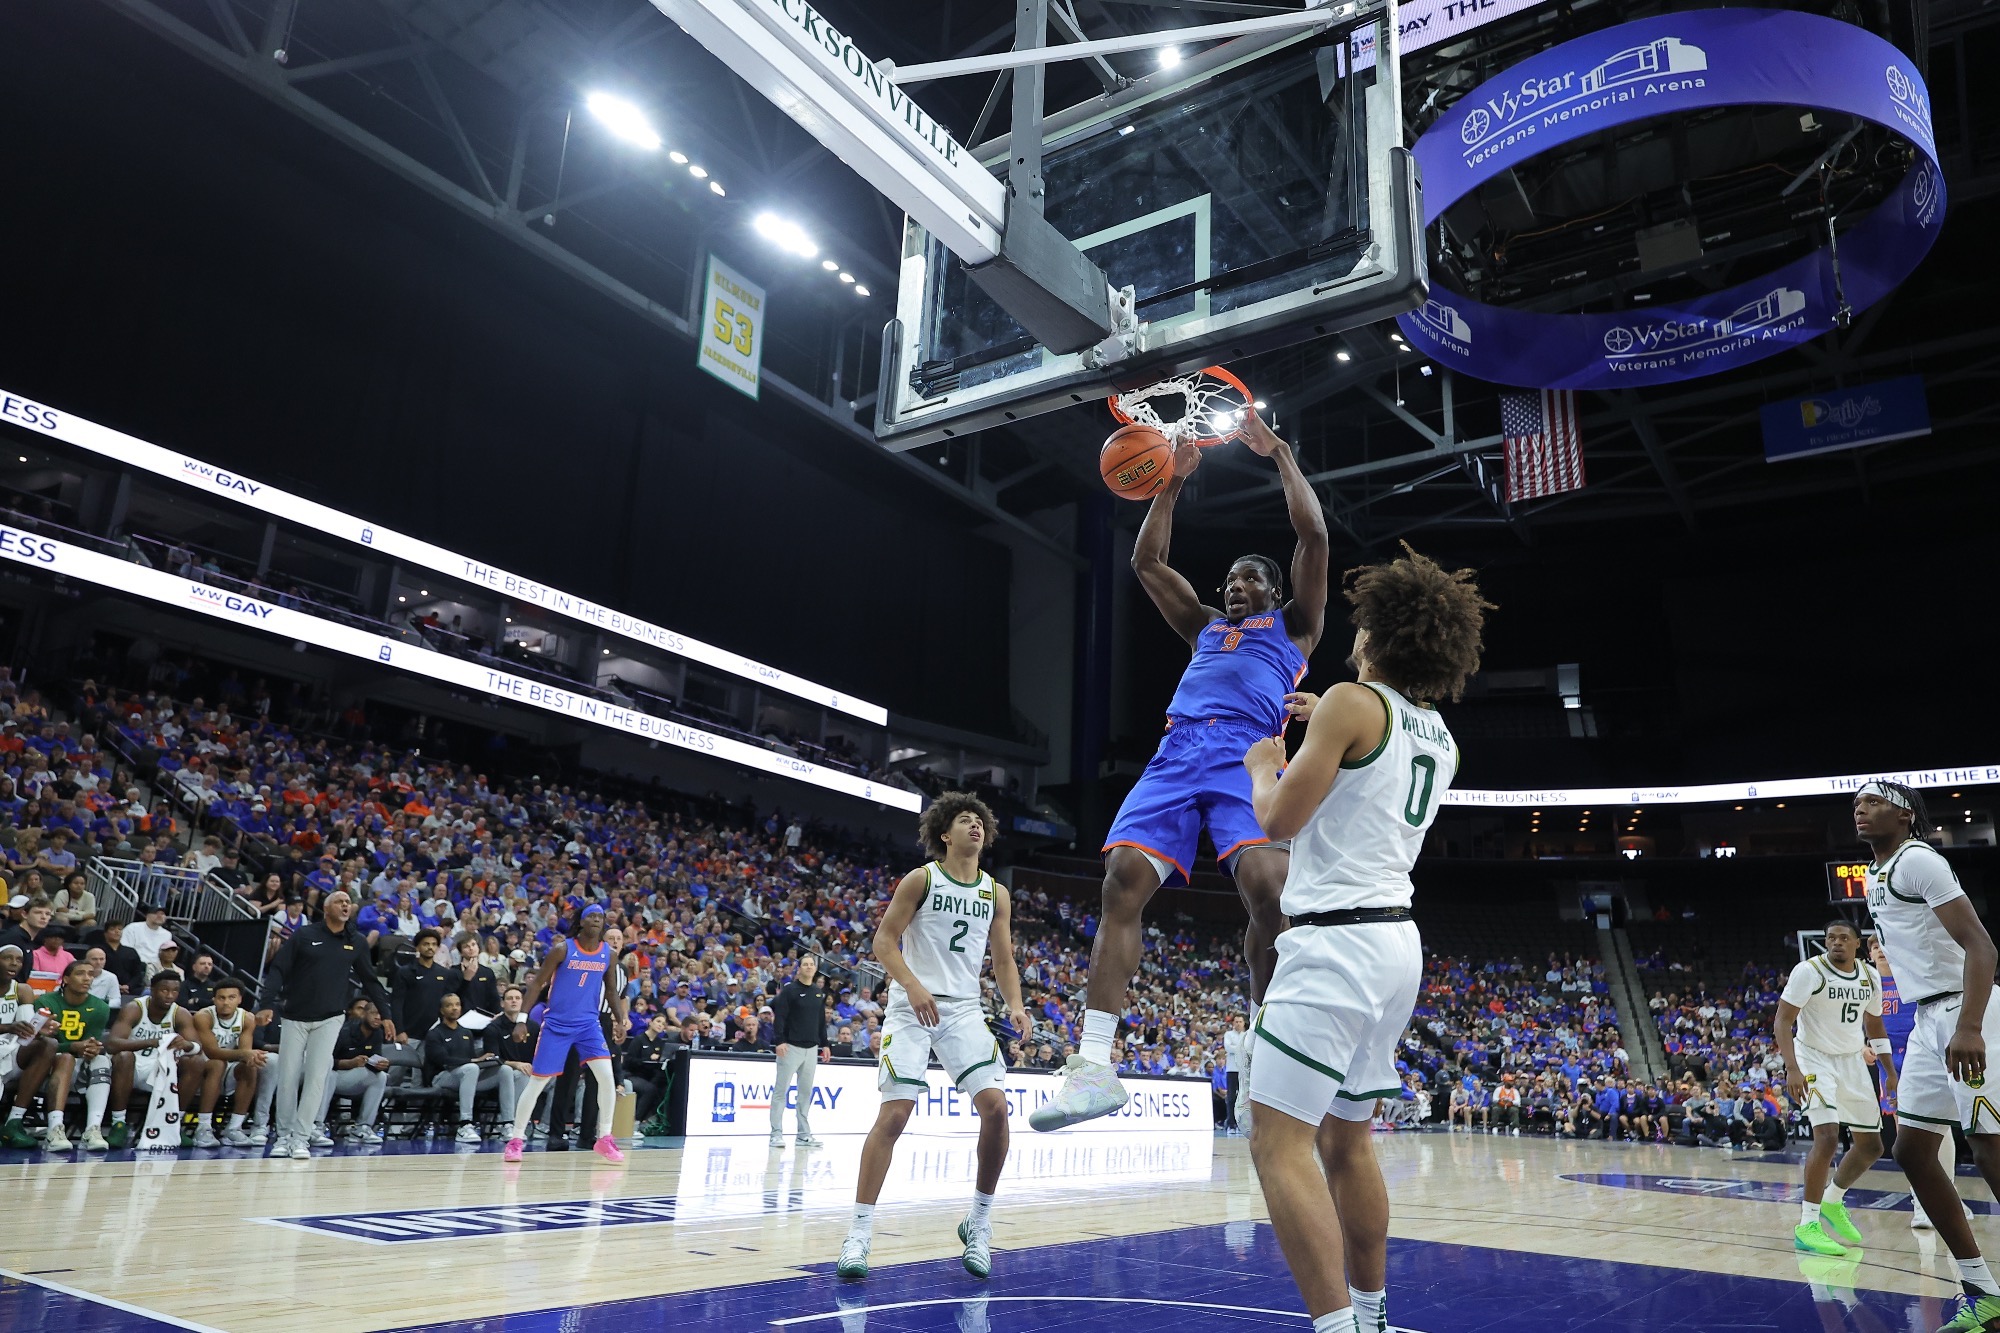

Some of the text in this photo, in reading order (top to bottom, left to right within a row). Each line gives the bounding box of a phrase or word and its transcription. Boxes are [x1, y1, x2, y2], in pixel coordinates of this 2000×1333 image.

[773, 0, 958, 168] CKSONVILLE
[1487, 71, 1575, 122] VyStar
[1466, 78, 1706, 169] Veterans Memorial Arena
[713, 297, 753, 358] 53
[1632, 319, 1708, 349] VyStar
[1441, 336, 1470, 357] Arena
[1609, 315, 1806, 372] Veterans Memorial Arena
[0, 393, 58, 430] ESS
[216, 473, 262, 496] GAY
[1117, 459, 1157, 487] ELITE
[225, 596, 273, 618] GAY
[463, 560, 685, 651] THE BEST IN THE BUSINESS
[1220, 631, 1244, 651] 9
[758, 666, 782, 681] GAY
[486, 671, 715, 751] THE BEST IN THE BUSINESS
[1400, 707, 1450, 752] WILLIAMS
[791, 761, 814, 775] GAY
[1828, 777, 1862, 790] THE
[1919, 772, 1937, 785] IN
[1943, 769, 1979, 783] THE
[1404, 754, 1436, 828] 0
[1445, 792, 1568, 803] IN THE BUSINESS
[1836, 864, 1869, 878] 18:00
[932, 894, 990, 920] BAYLOR
[949, 920, 969, 953] 2
[578, 971, 588, 987] 1
[1828, 987, 1871, 1000] BAYLOR
[0, 1002, 15, 1013] OR
[1841, 1002, 1860, 1023] 15
[1882, 1000, 1899, 1015] 21
